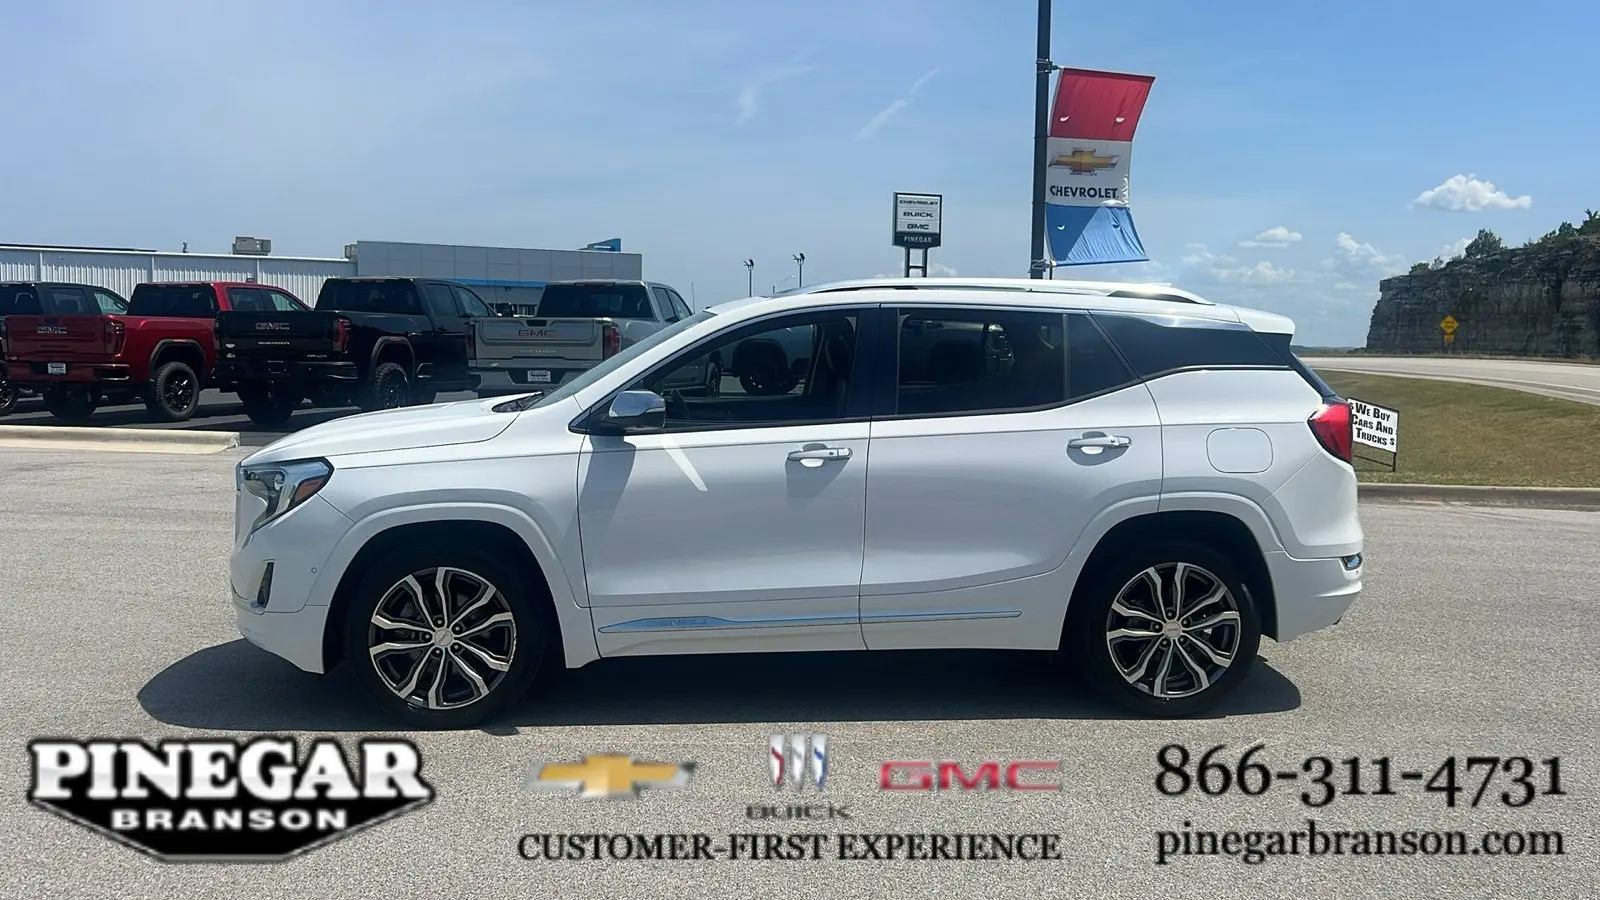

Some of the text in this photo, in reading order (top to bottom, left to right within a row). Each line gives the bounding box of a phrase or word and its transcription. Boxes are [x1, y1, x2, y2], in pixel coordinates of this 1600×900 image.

[1050, 185, 1119, 199] CHEVROLET
[255, 322, 290, 330] GMC
[518, 329, 553, 337] GMC
